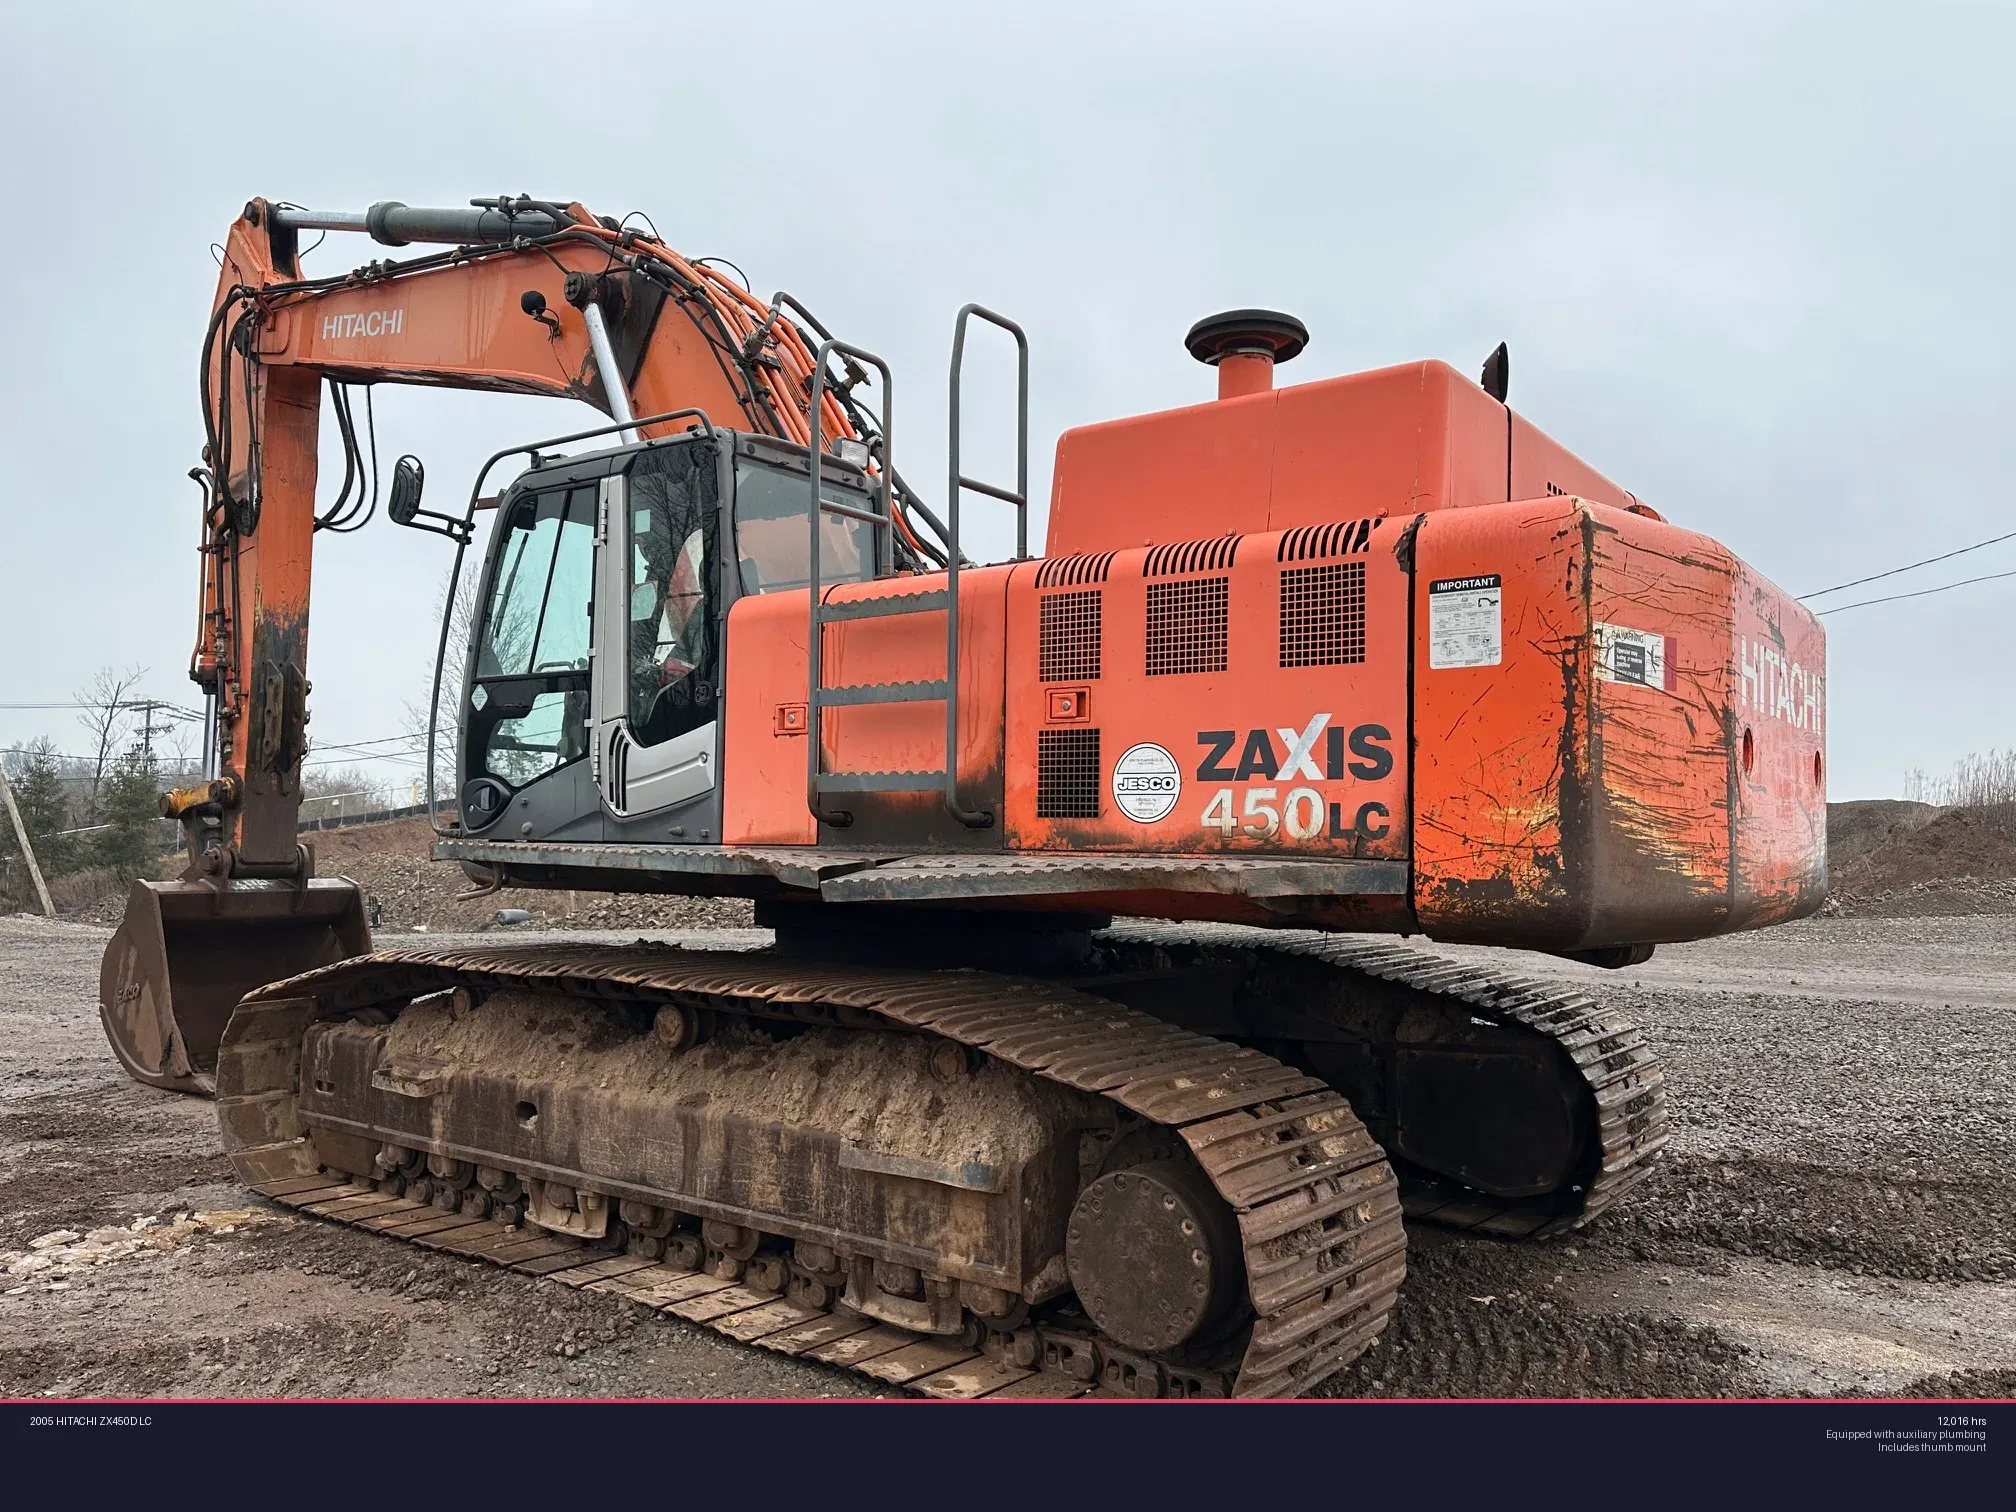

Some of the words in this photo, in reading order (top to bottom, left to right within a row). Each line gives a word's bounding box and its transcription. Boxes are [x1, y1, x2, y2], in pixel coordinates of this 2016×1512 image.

[323, 309, 403, 339] HITACHI
[1437, 577, 1495, 591] IMPORTANT
[1621, 630, 1644, 644] WARNING
[1741, 634, 1821, 735] HITACHI
[1196, 712, 1394, 782] ZAXIS
[1117, 776, 1176, 791] JESCO
